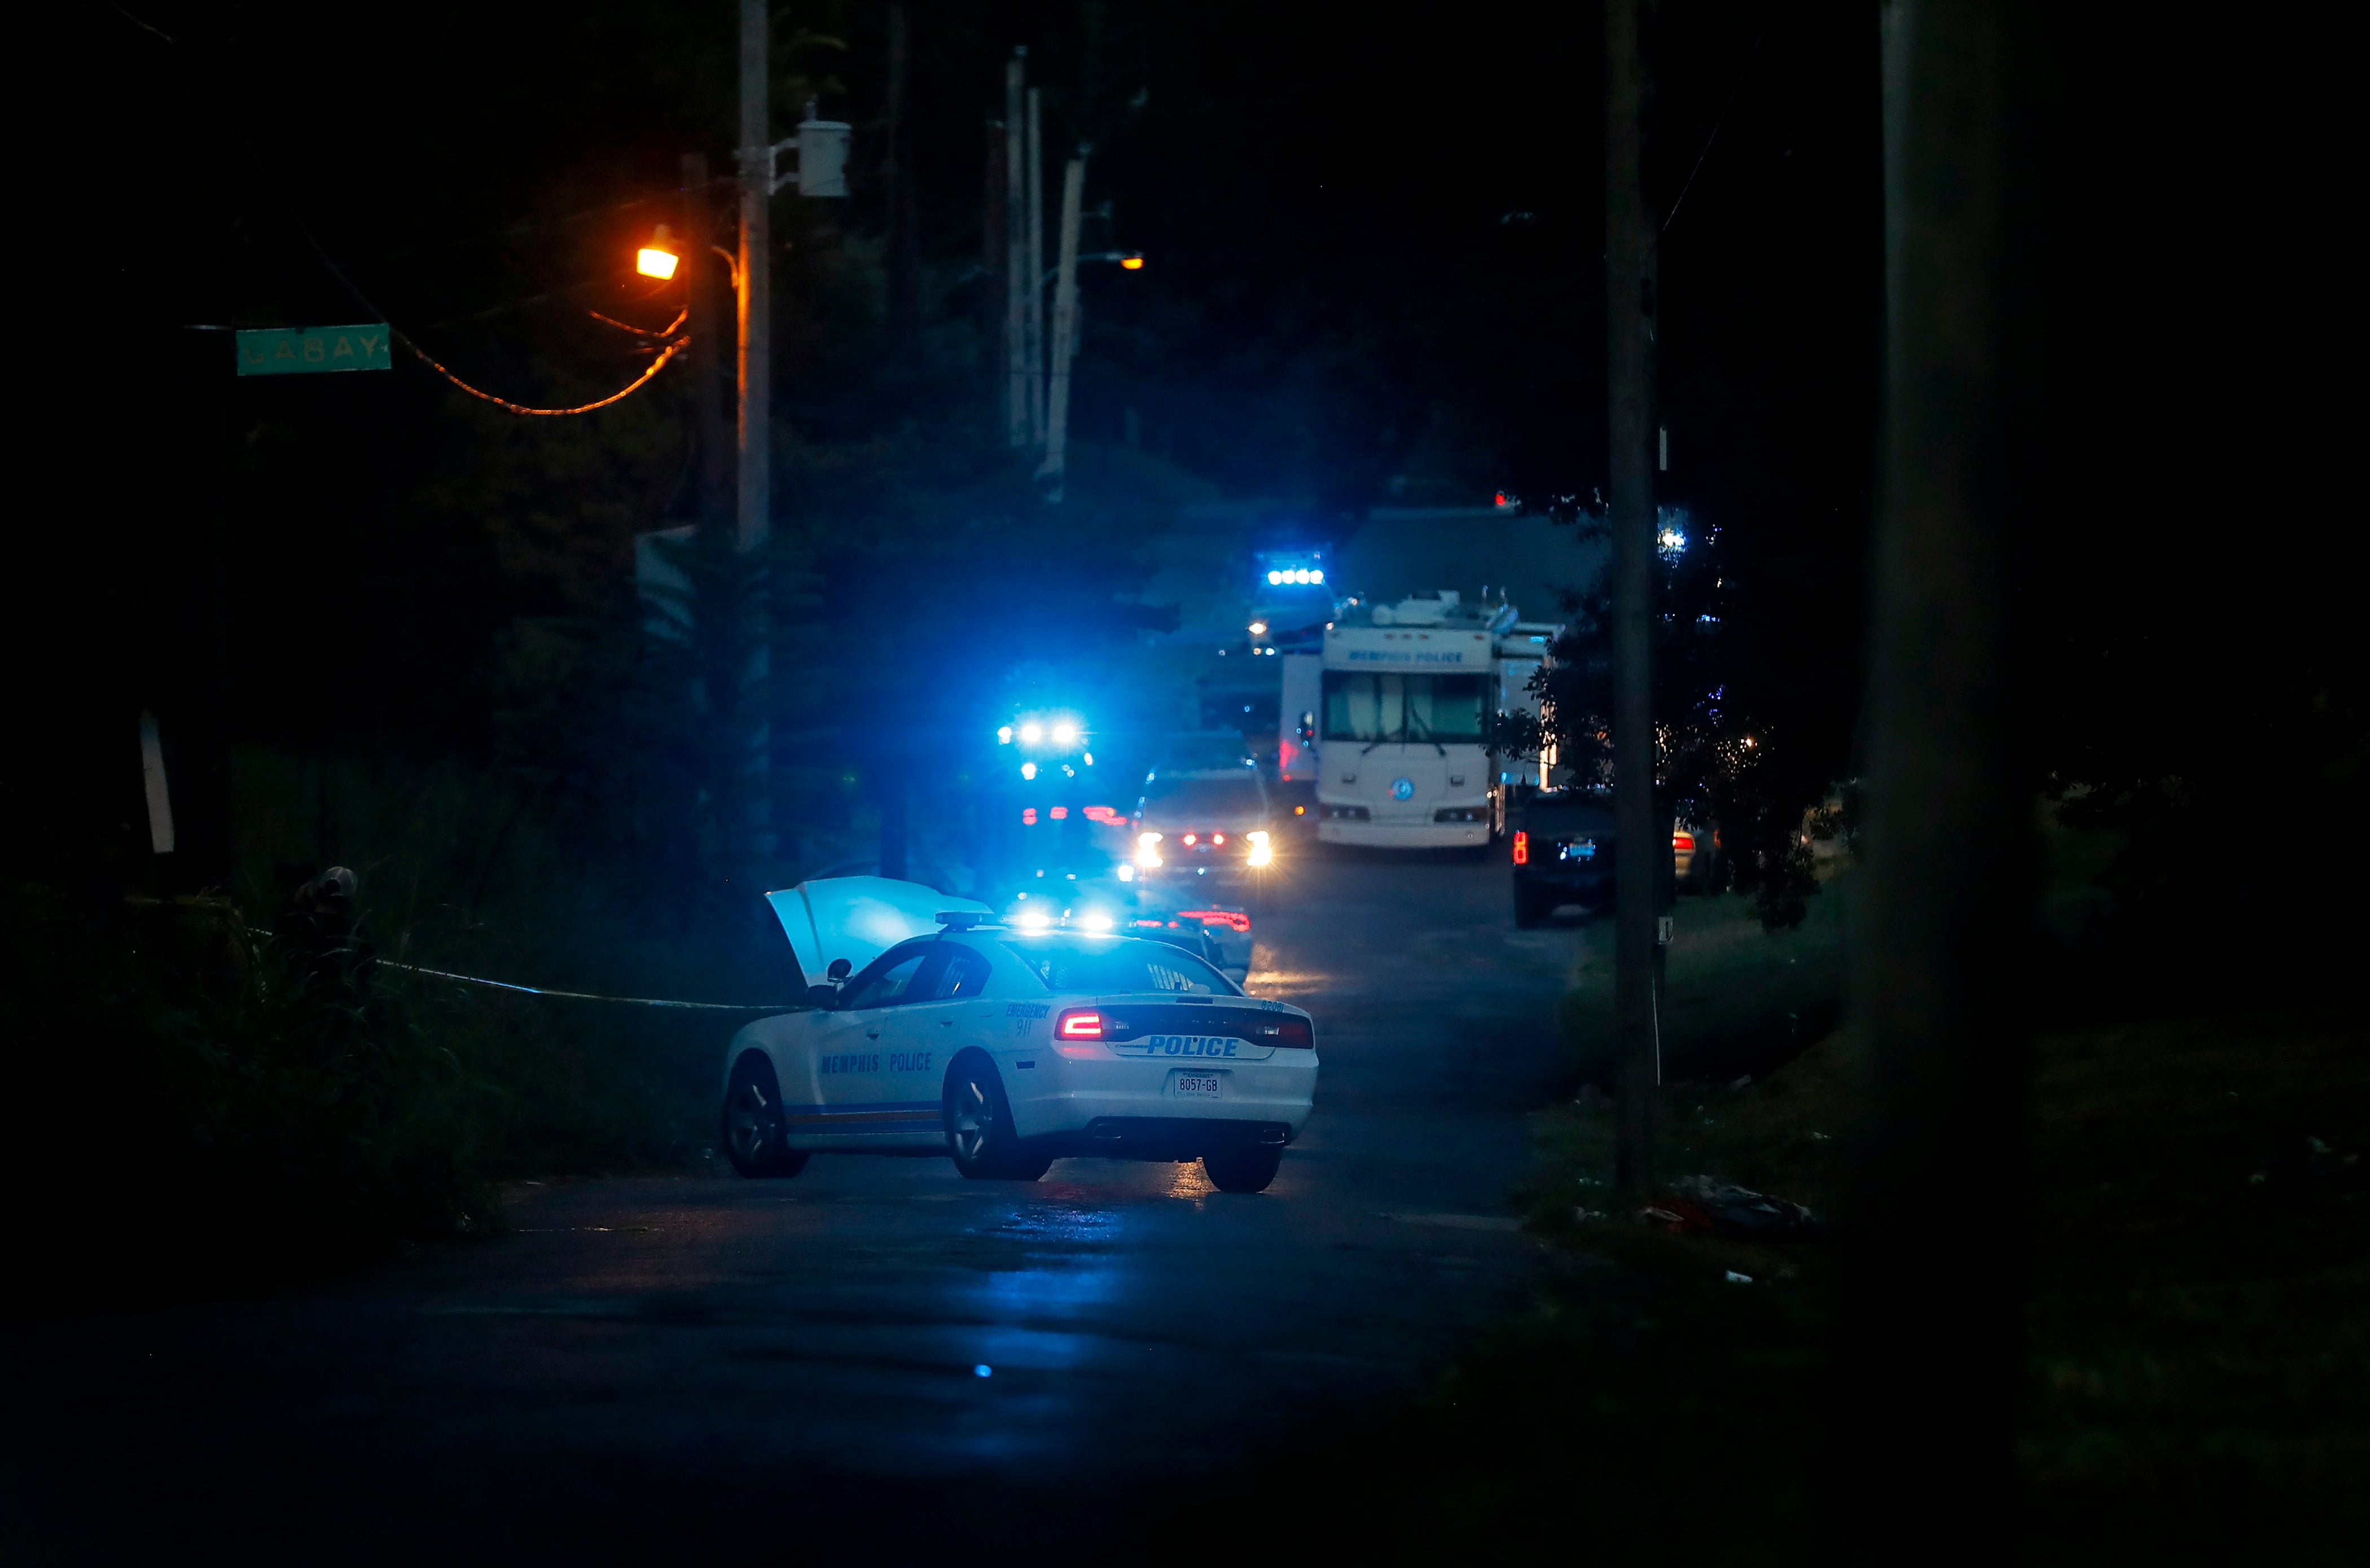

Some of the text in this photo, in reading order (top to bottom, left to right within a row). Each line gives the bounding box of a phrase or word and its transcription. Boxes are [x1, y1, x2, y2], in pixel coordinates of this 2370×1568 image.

[1006, 1003, 1051, 1019] EMERGENCY
[1017, 1018, 1032, 1036] 911
[1147, 1035, 1239, 1057] POLICE
[822, 1052, 932, 1073] MEMPHIS POLICE
[1180, 1078, 1217, 1091] 8057-GB
